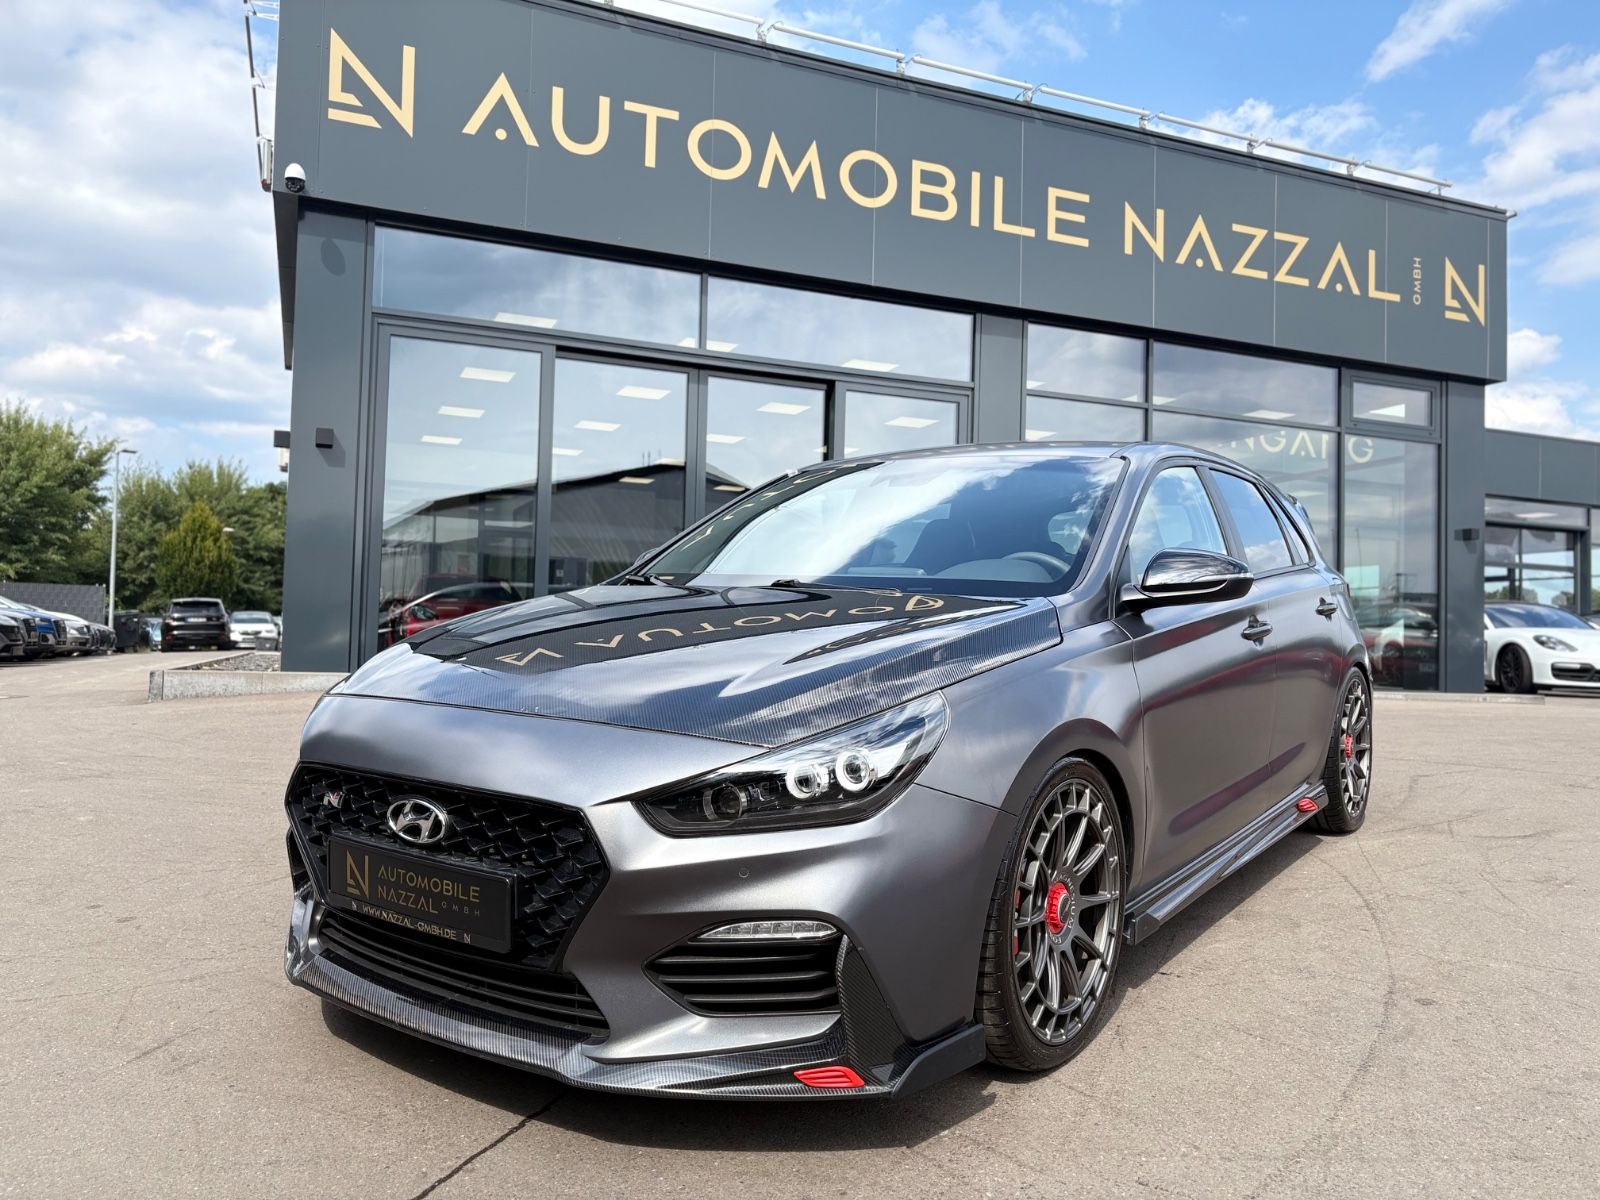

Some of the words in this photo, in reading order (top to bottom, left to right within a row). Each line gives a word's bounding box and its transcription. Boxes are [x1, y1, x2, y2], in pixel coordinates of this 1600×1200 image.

[461, 72, 1090, 248] AUTOMOBILE
[1123, 200, 1401, 302] NAZZAL
[1413, 257, 1421, 305] GMBH
[377, 885, 439, 914] NAZZAL
[441, 900, 480, 917] GMBH
[378, 864, 480, 902] AUTOMOBILE
